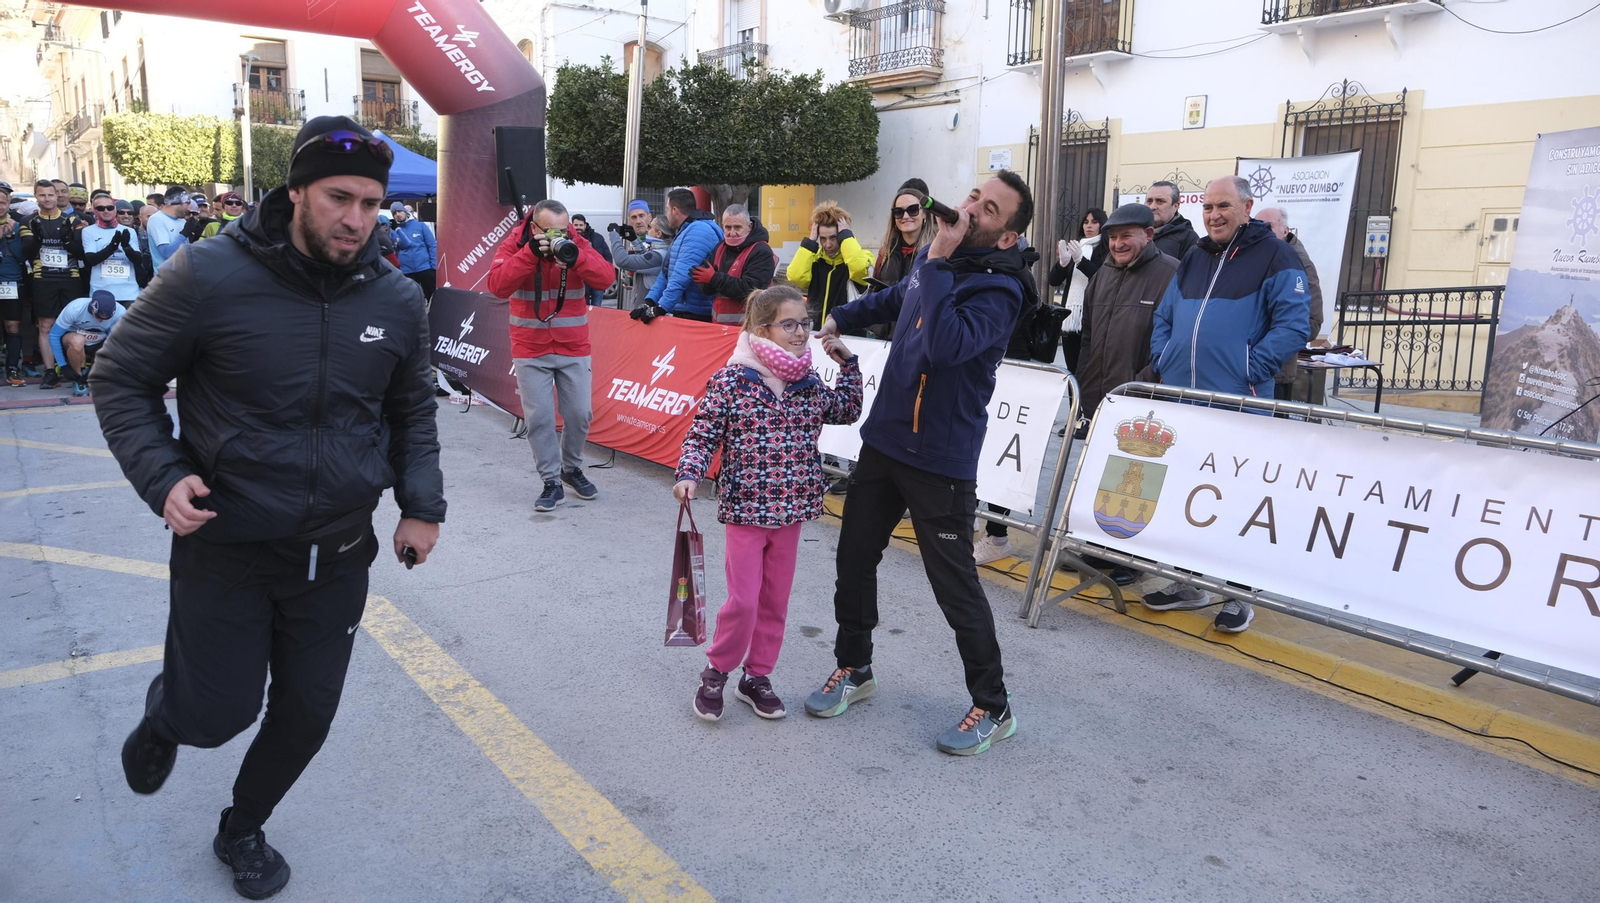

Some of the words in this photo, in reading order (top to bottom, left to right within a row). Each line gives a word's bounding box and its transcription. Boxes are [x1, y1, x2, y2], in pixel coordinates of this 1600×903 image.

[407, 0, 496, 92] TEAMERGY
[45, 254, 62, 263] 313
[107, 265, 125, 275] 358
[365, 325, 386, 339] NIKE
[434, 336, 490, 365] TEAMERGY
[607, 378, 703, 417] TEAMERGY
[997, 402, 1030, 425] DE
[1199, 452, 1600, 541] AYUNTAMIENT
[1184, 483, 1600, 617] CANTOR
